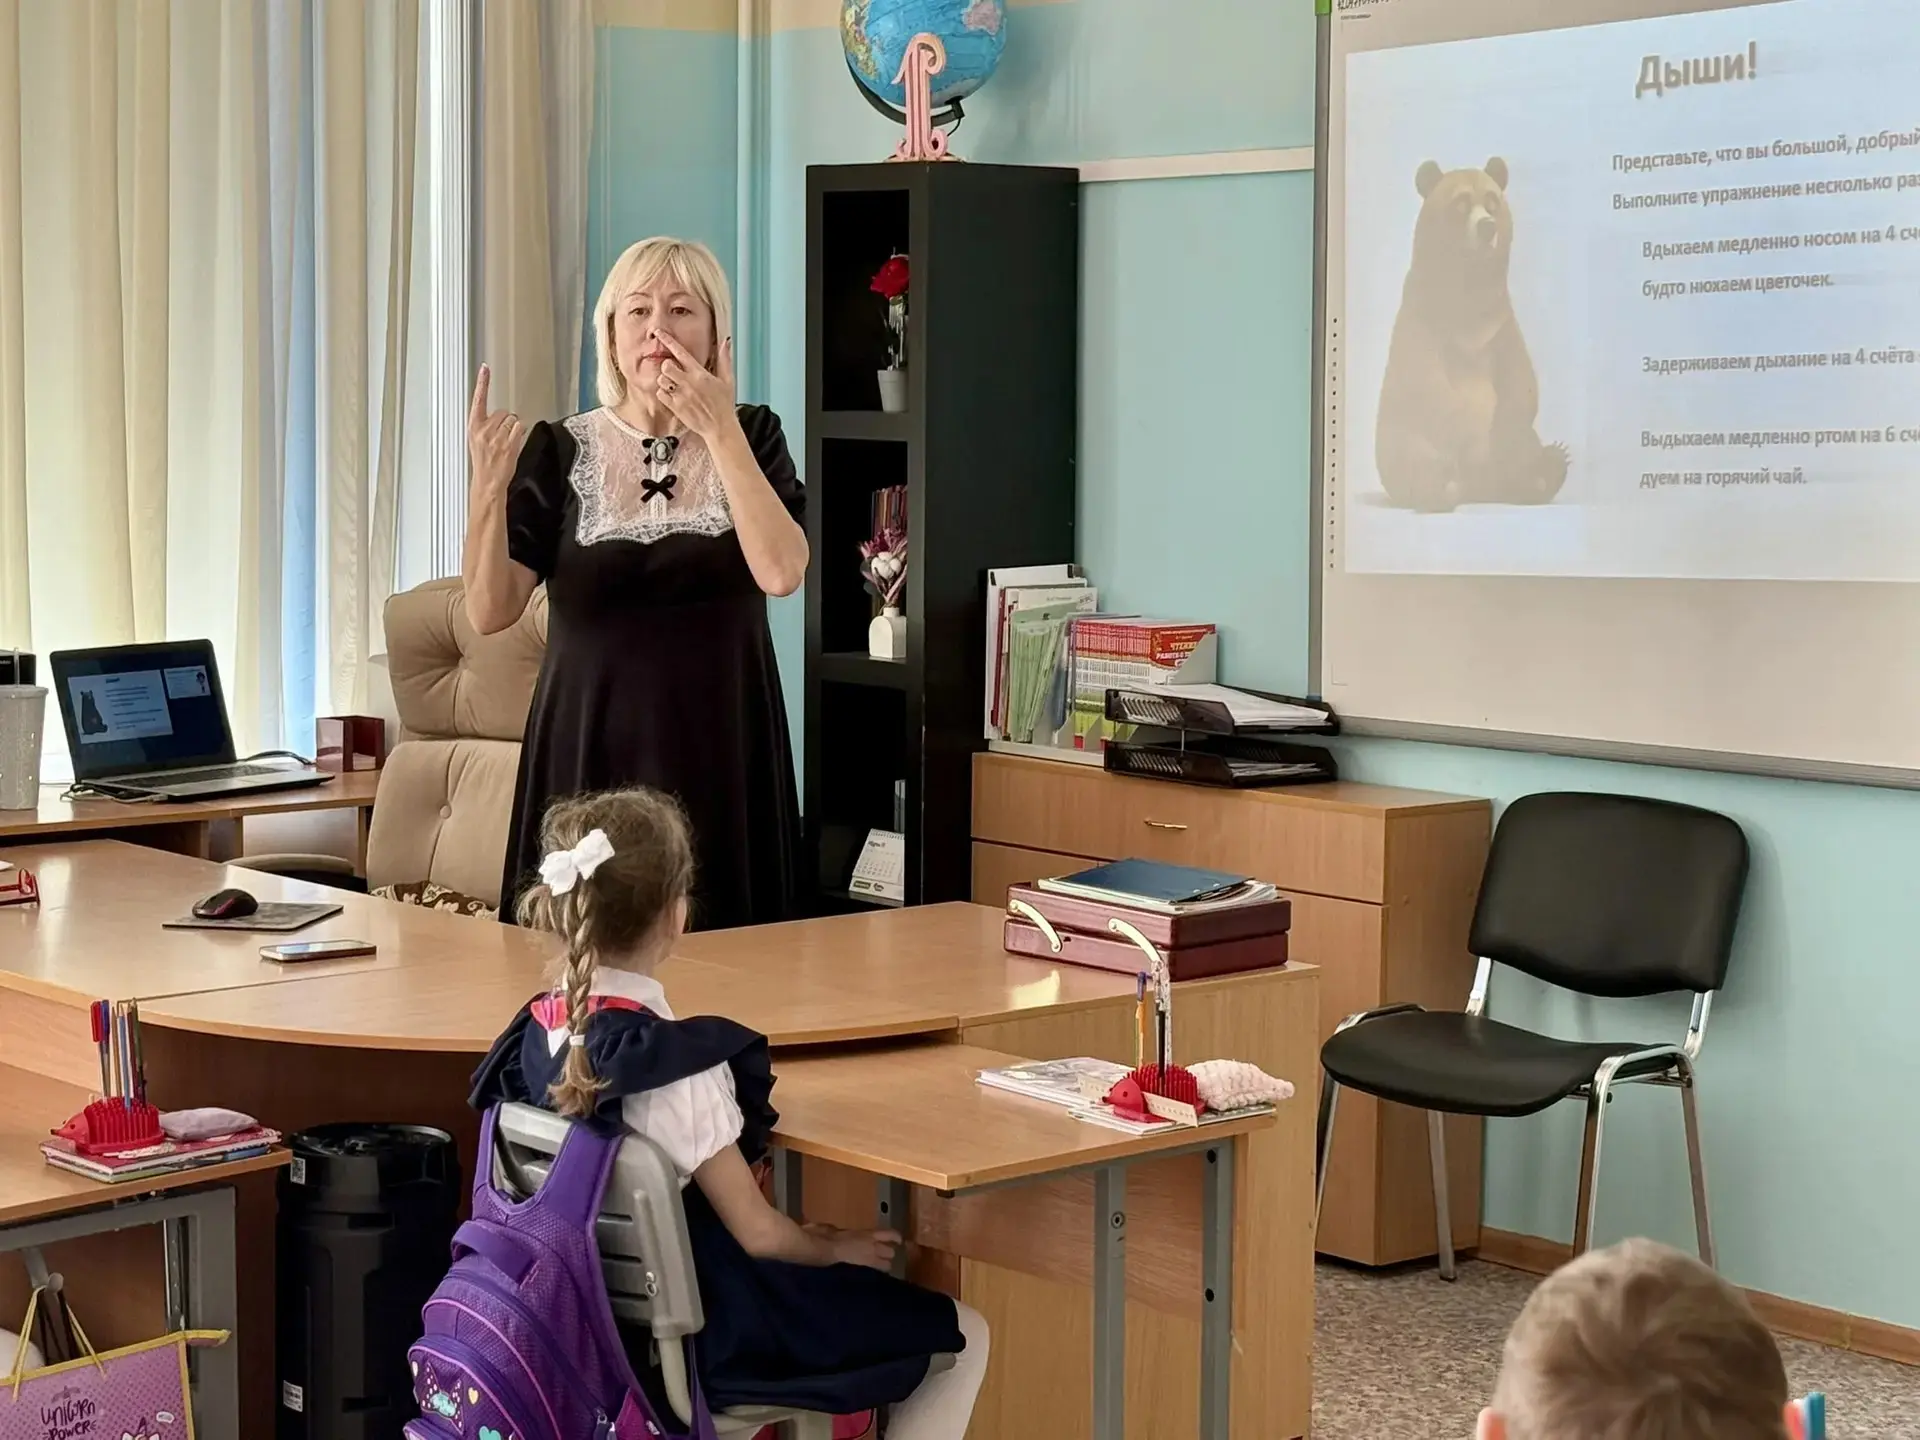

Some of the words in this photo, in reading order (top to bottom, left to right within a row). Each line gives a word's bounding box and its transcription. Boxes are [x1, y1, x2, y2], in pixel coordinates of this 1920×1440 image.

[1635, 40, 1757, 99] Дыши!
[1612, 150, 1712, 173] Представьте,
[1716, 148, 1742, 161] что
[1747, 146, 1768, 159] вы
[1772, 134, 1852, 157] большой,
[1612, 191, 1698, 210] Выполните
[1702, 183, 1802, 207] упражнение
[1806, 175, 1892, 195] несколько
[1897, 173, 1920, 192] ра
[1642, 239, 1713, 260] Вдыхаем
[1717, 233, 1799, 255] медленно
[1804, 230, 1857, 248] носом
[1861, 230, 1881, 244] на
[1885, 224, 1896, 241] 4
[1900, 226, 1920, 242] сч
[1642, 280, 1685, 300] будто
[1690, 277, 1751, 294] нюхаем
[1755, 272, 1834, 294] цветочек.
[1642, 356, 1750, 376] Задерживаем
[1754, 353, 1827, 373] дыхание
[1831, 351, 1850, 366] на
[1855, 348, 1867, 365] 4
[1869, 345, 1914, 364] счёта
[1641, 430, 1725, 450] Выдыхаем
[1728, 429, 1810, 448] медленно
[1815, 430, 1856, 447] ртом
[1861, 430, 1881, 443] на
[1885, 425, 1895, 442] 6
[1900, 427, 1920, 442] сч
[1640, 471, 1680, 489] дуем
[1684, 471, 1702, 486] на
[1706, 467, 1770, 488] горячий
[1773, 466, 1808, 485] чай.
